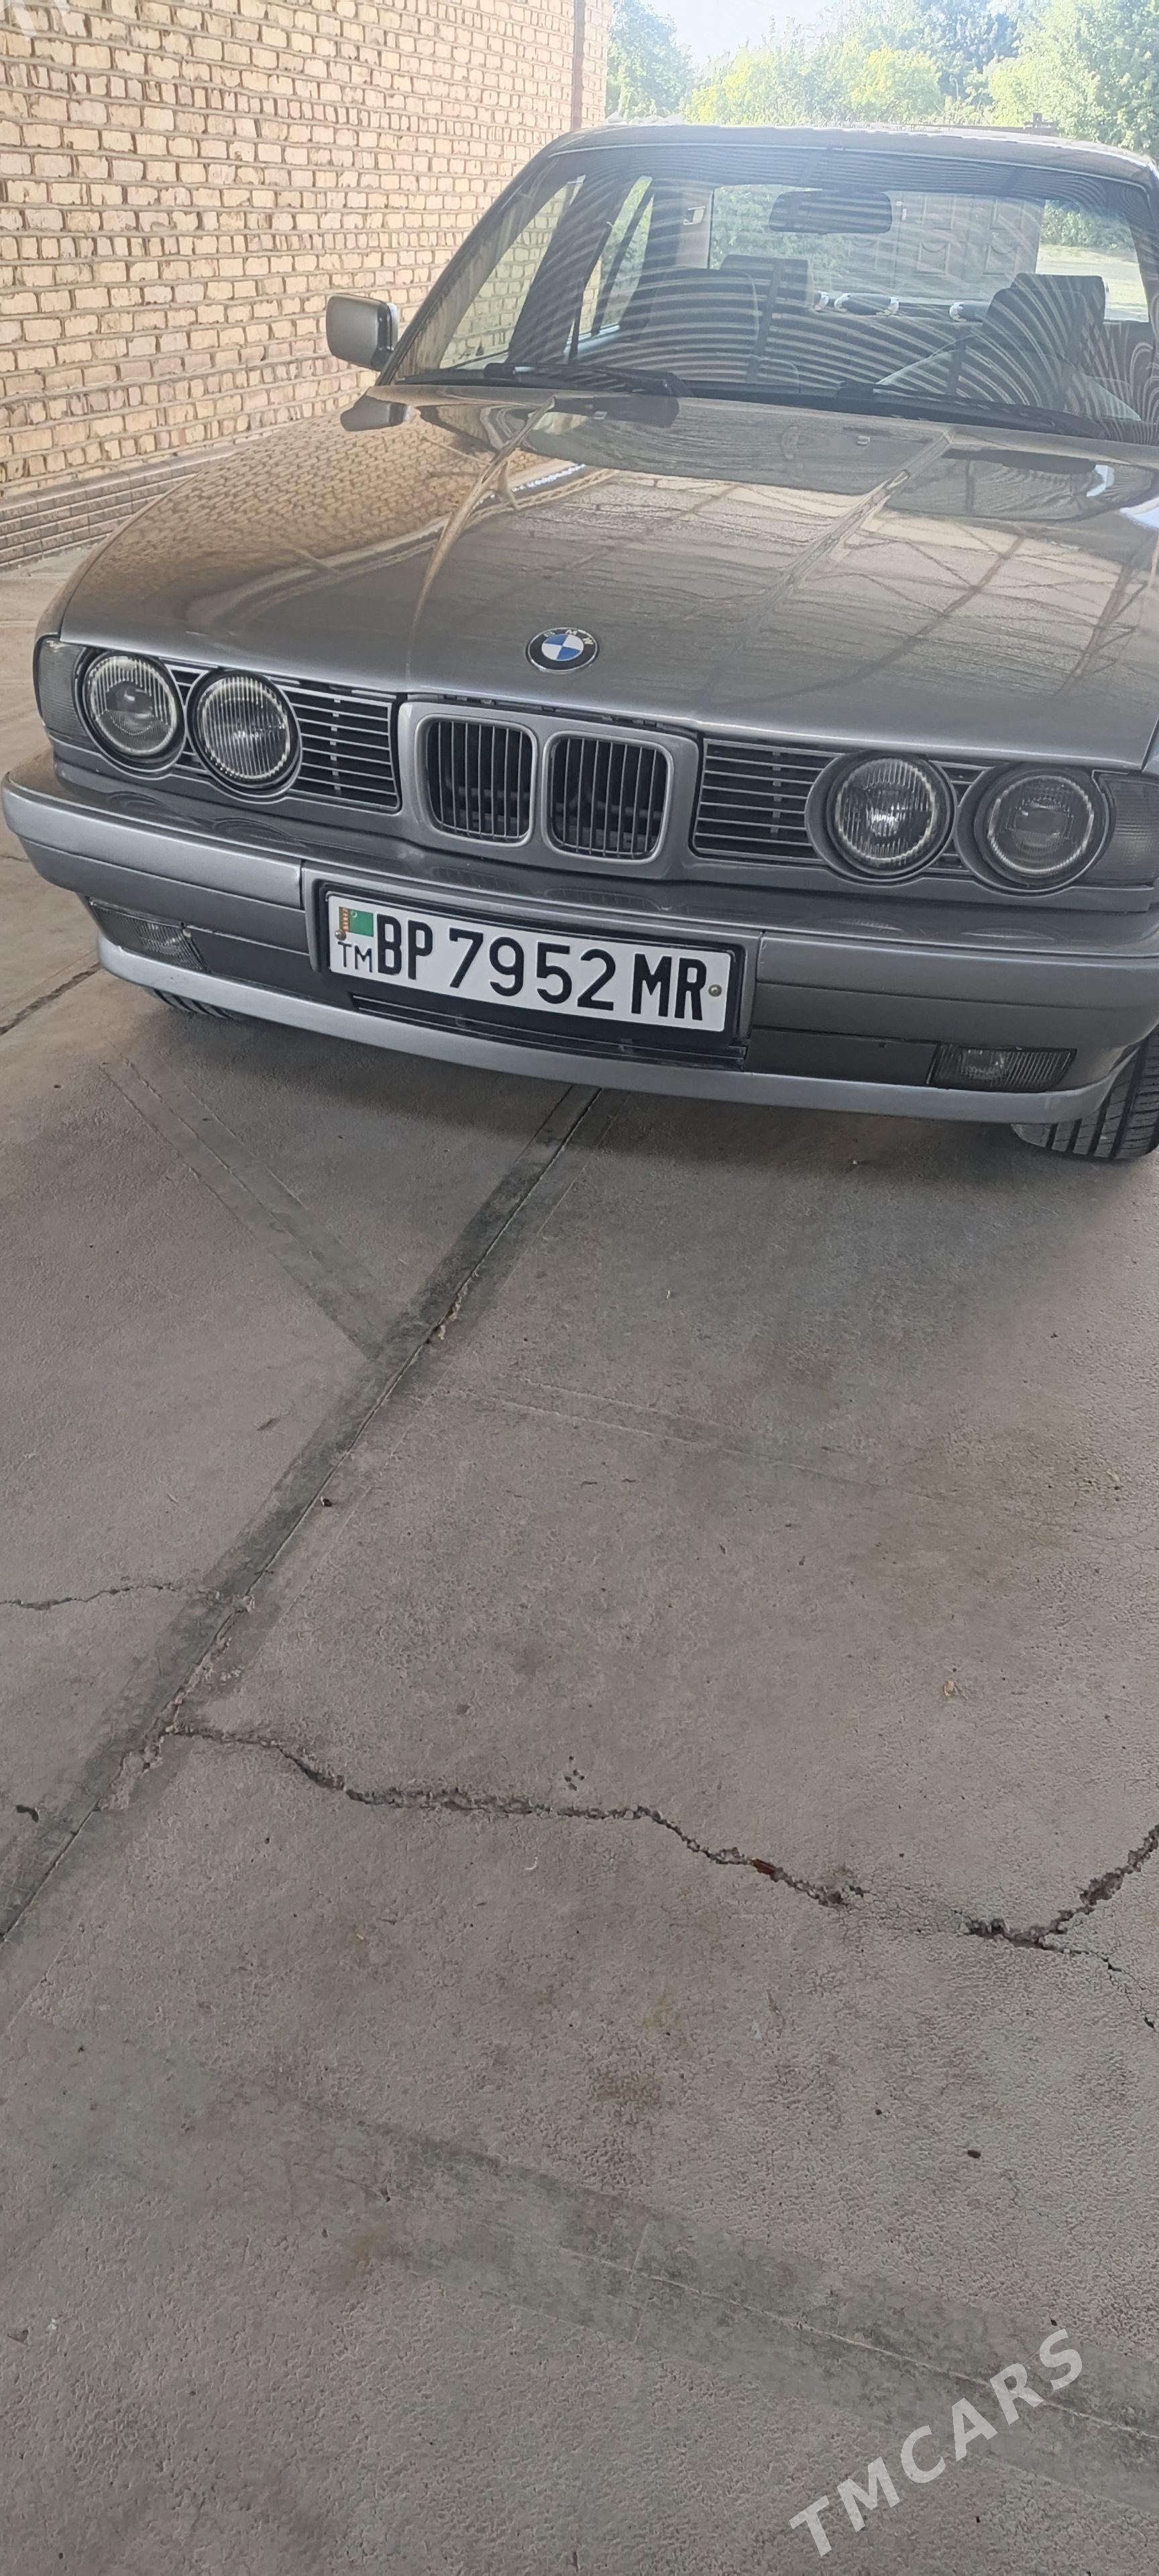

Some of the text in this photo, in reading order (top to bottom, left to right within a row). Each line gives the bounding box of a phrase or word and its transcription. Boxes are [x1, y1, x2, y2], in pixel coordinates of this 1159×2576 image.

[337, 941, 373, 973] TM
[377, 913, 707, 1021] BP 7952 MR
